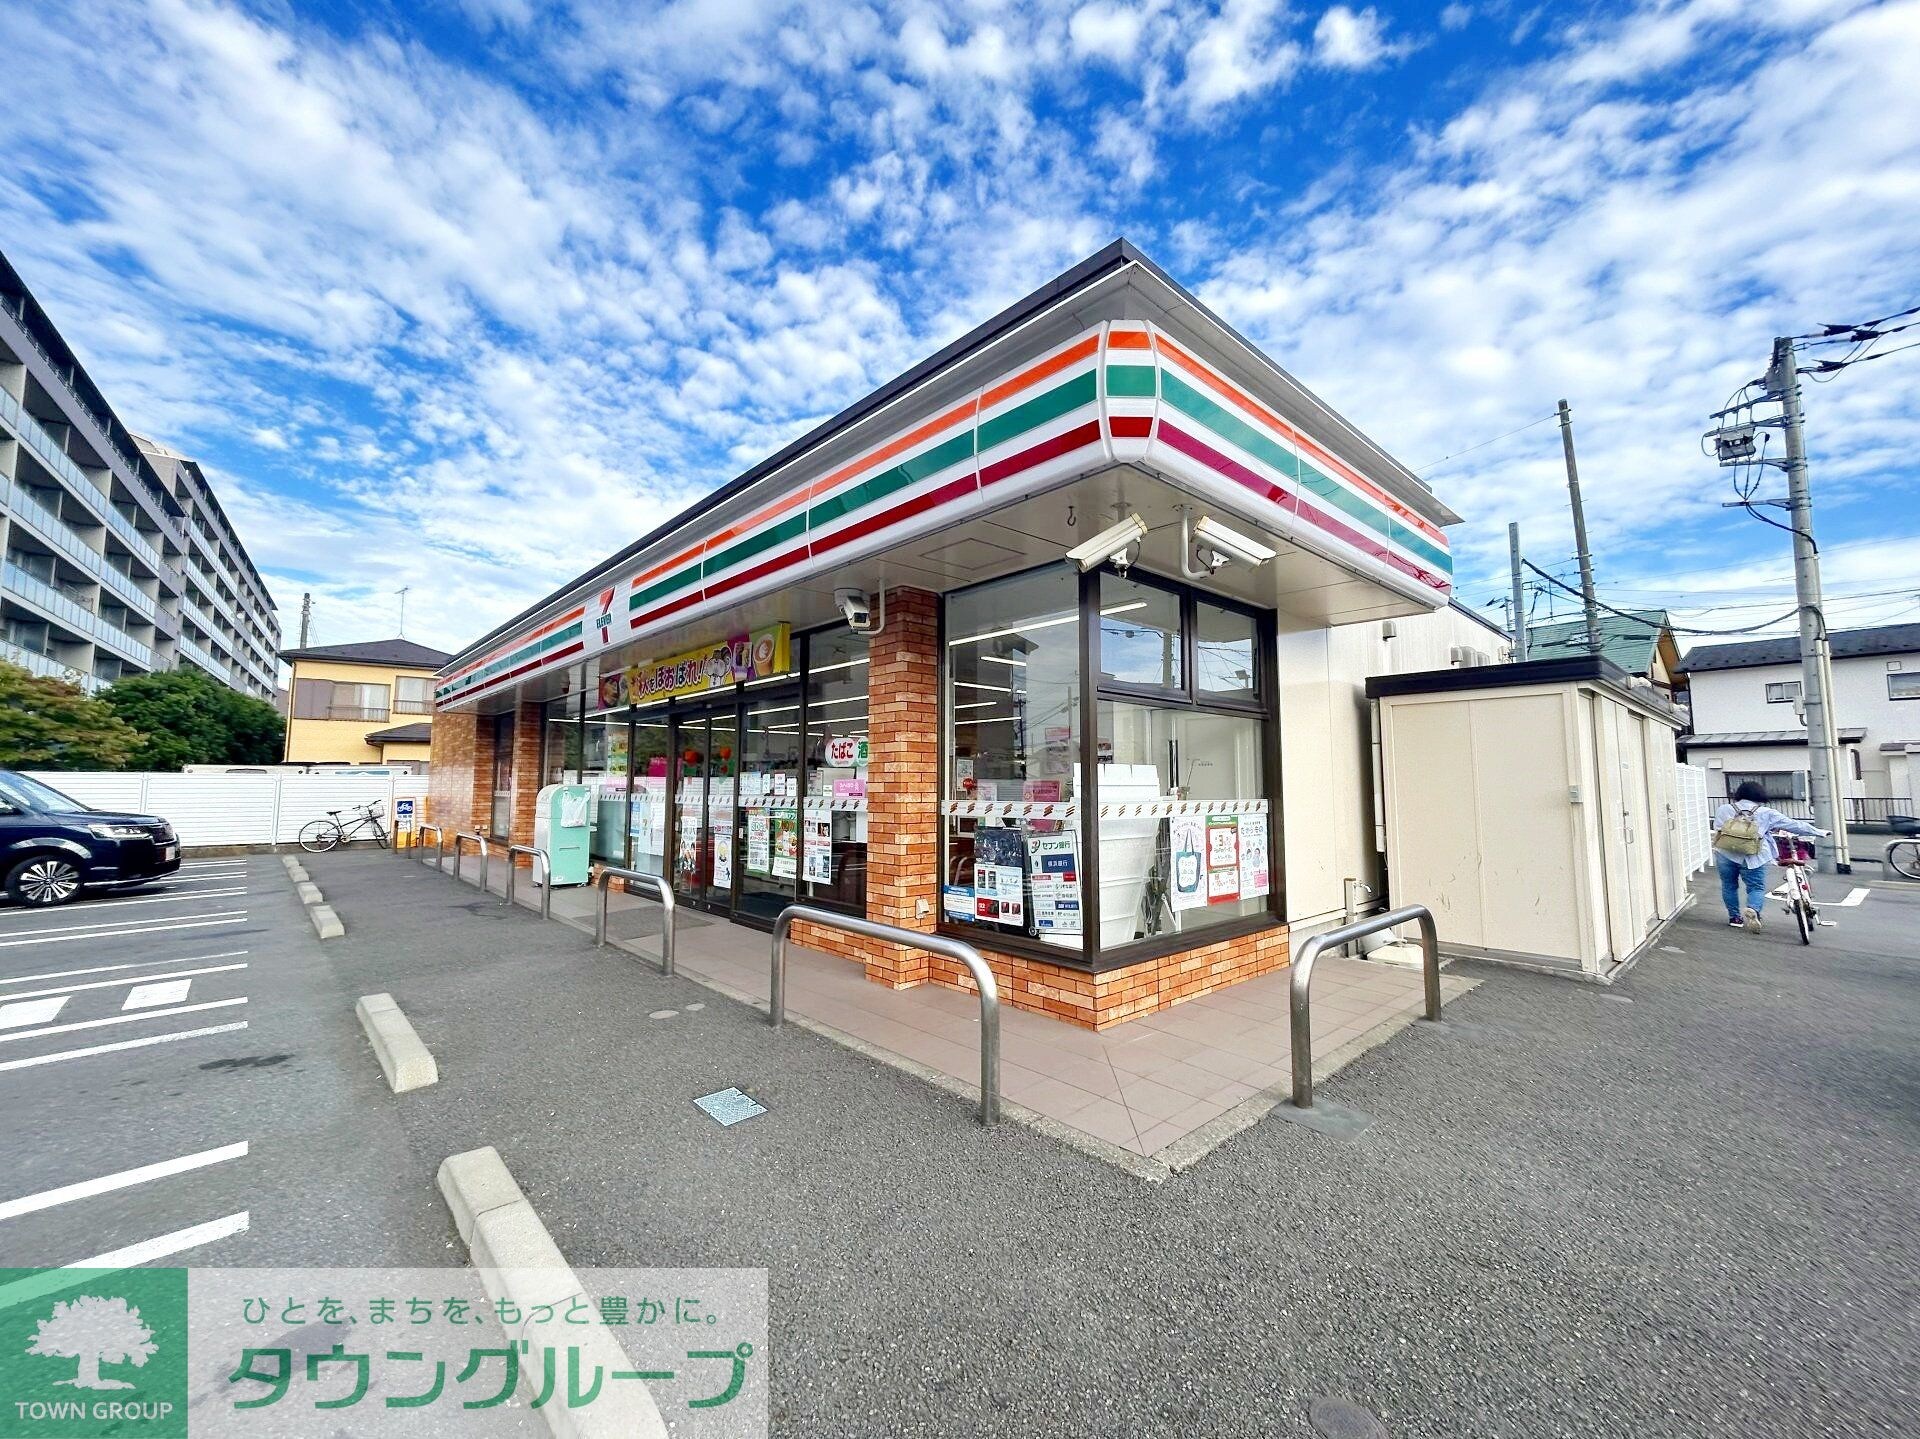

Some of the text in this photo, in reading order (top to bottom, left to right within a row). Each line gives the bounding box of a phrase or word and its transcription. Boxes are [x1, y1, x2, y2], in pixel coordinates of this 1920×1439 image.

[831, 741, 854, 760] たばこ
[857, 741, 869, 759] 酒
[1042, 840, 1071, 850] セブン銀行
